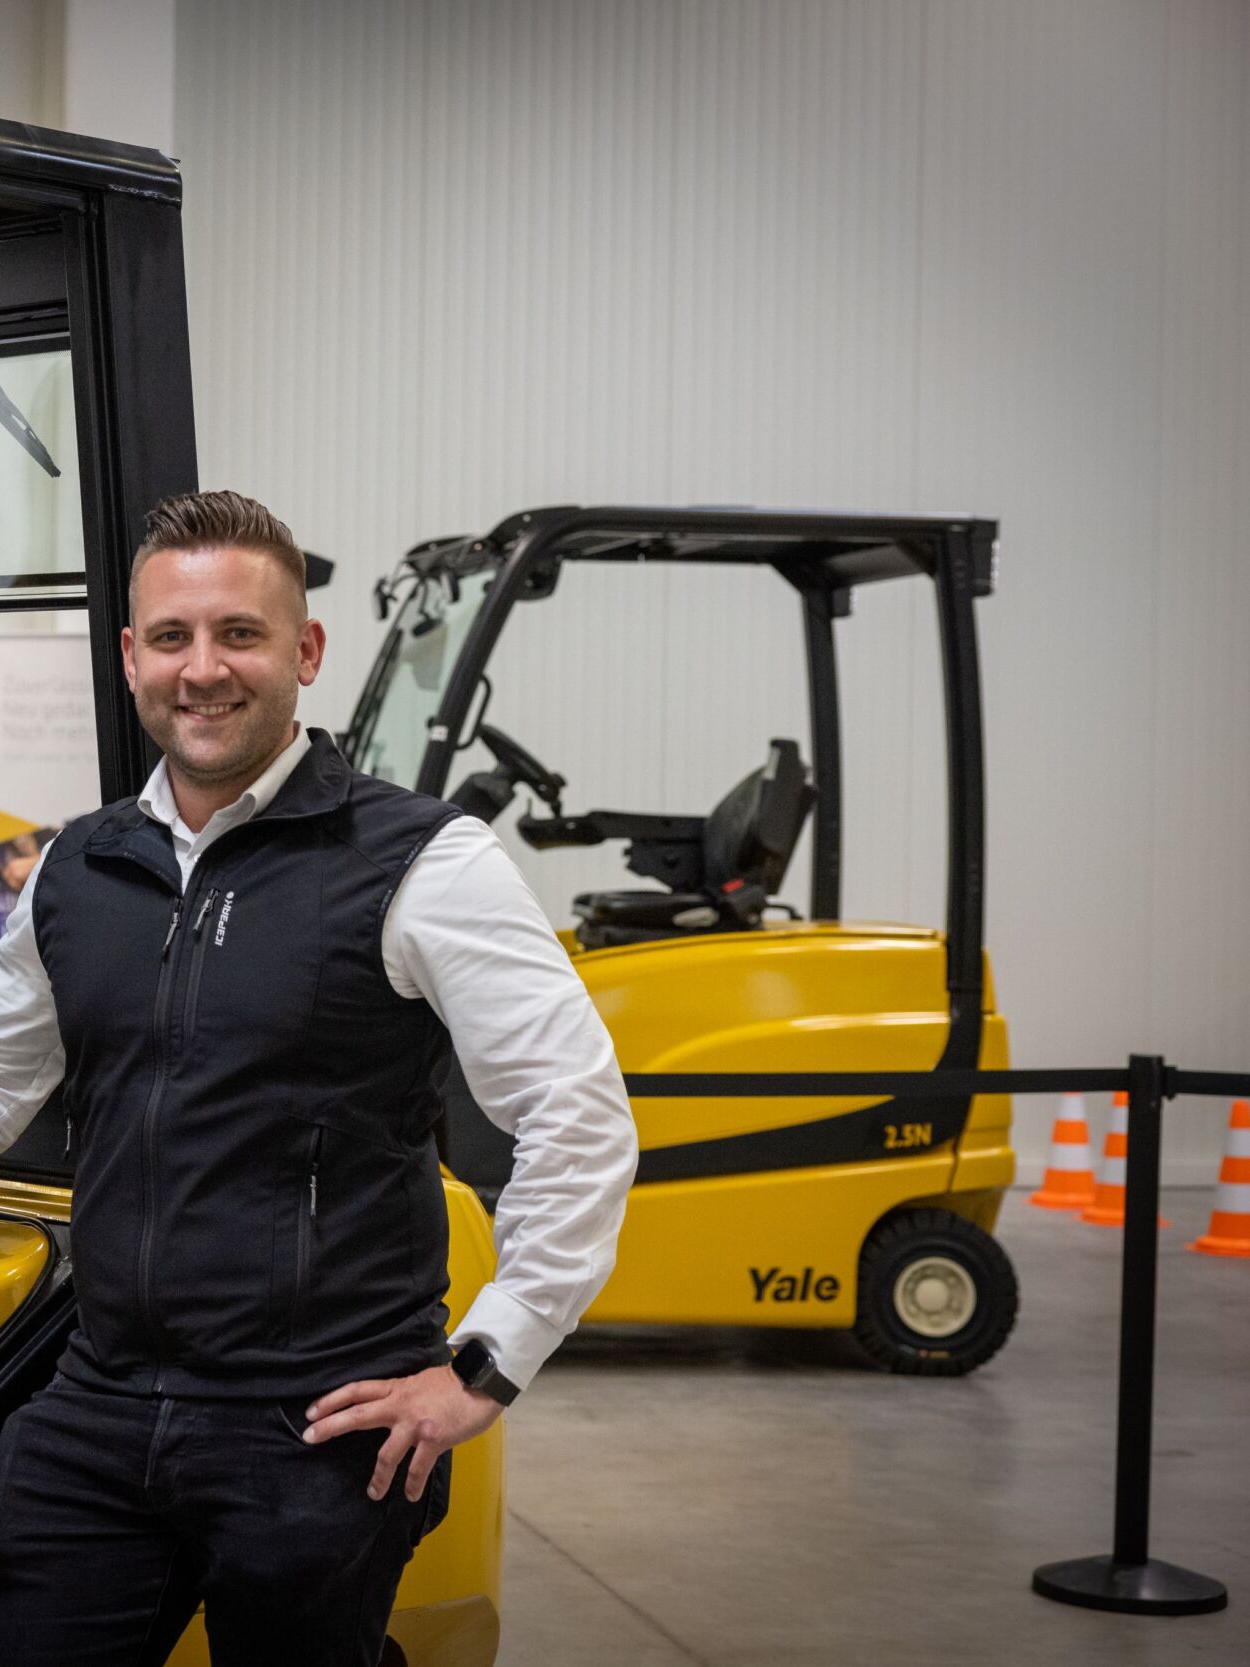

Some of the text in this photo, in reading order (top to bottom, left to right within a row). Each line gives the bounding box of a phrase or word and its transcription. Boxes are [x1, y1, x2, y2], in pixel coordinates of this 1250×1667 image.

[214, 898, 234, 947] ICEPEAK
[883, 1122, 932, 1149] 2.5N
[748, 1267, 840, 1302] Yale
